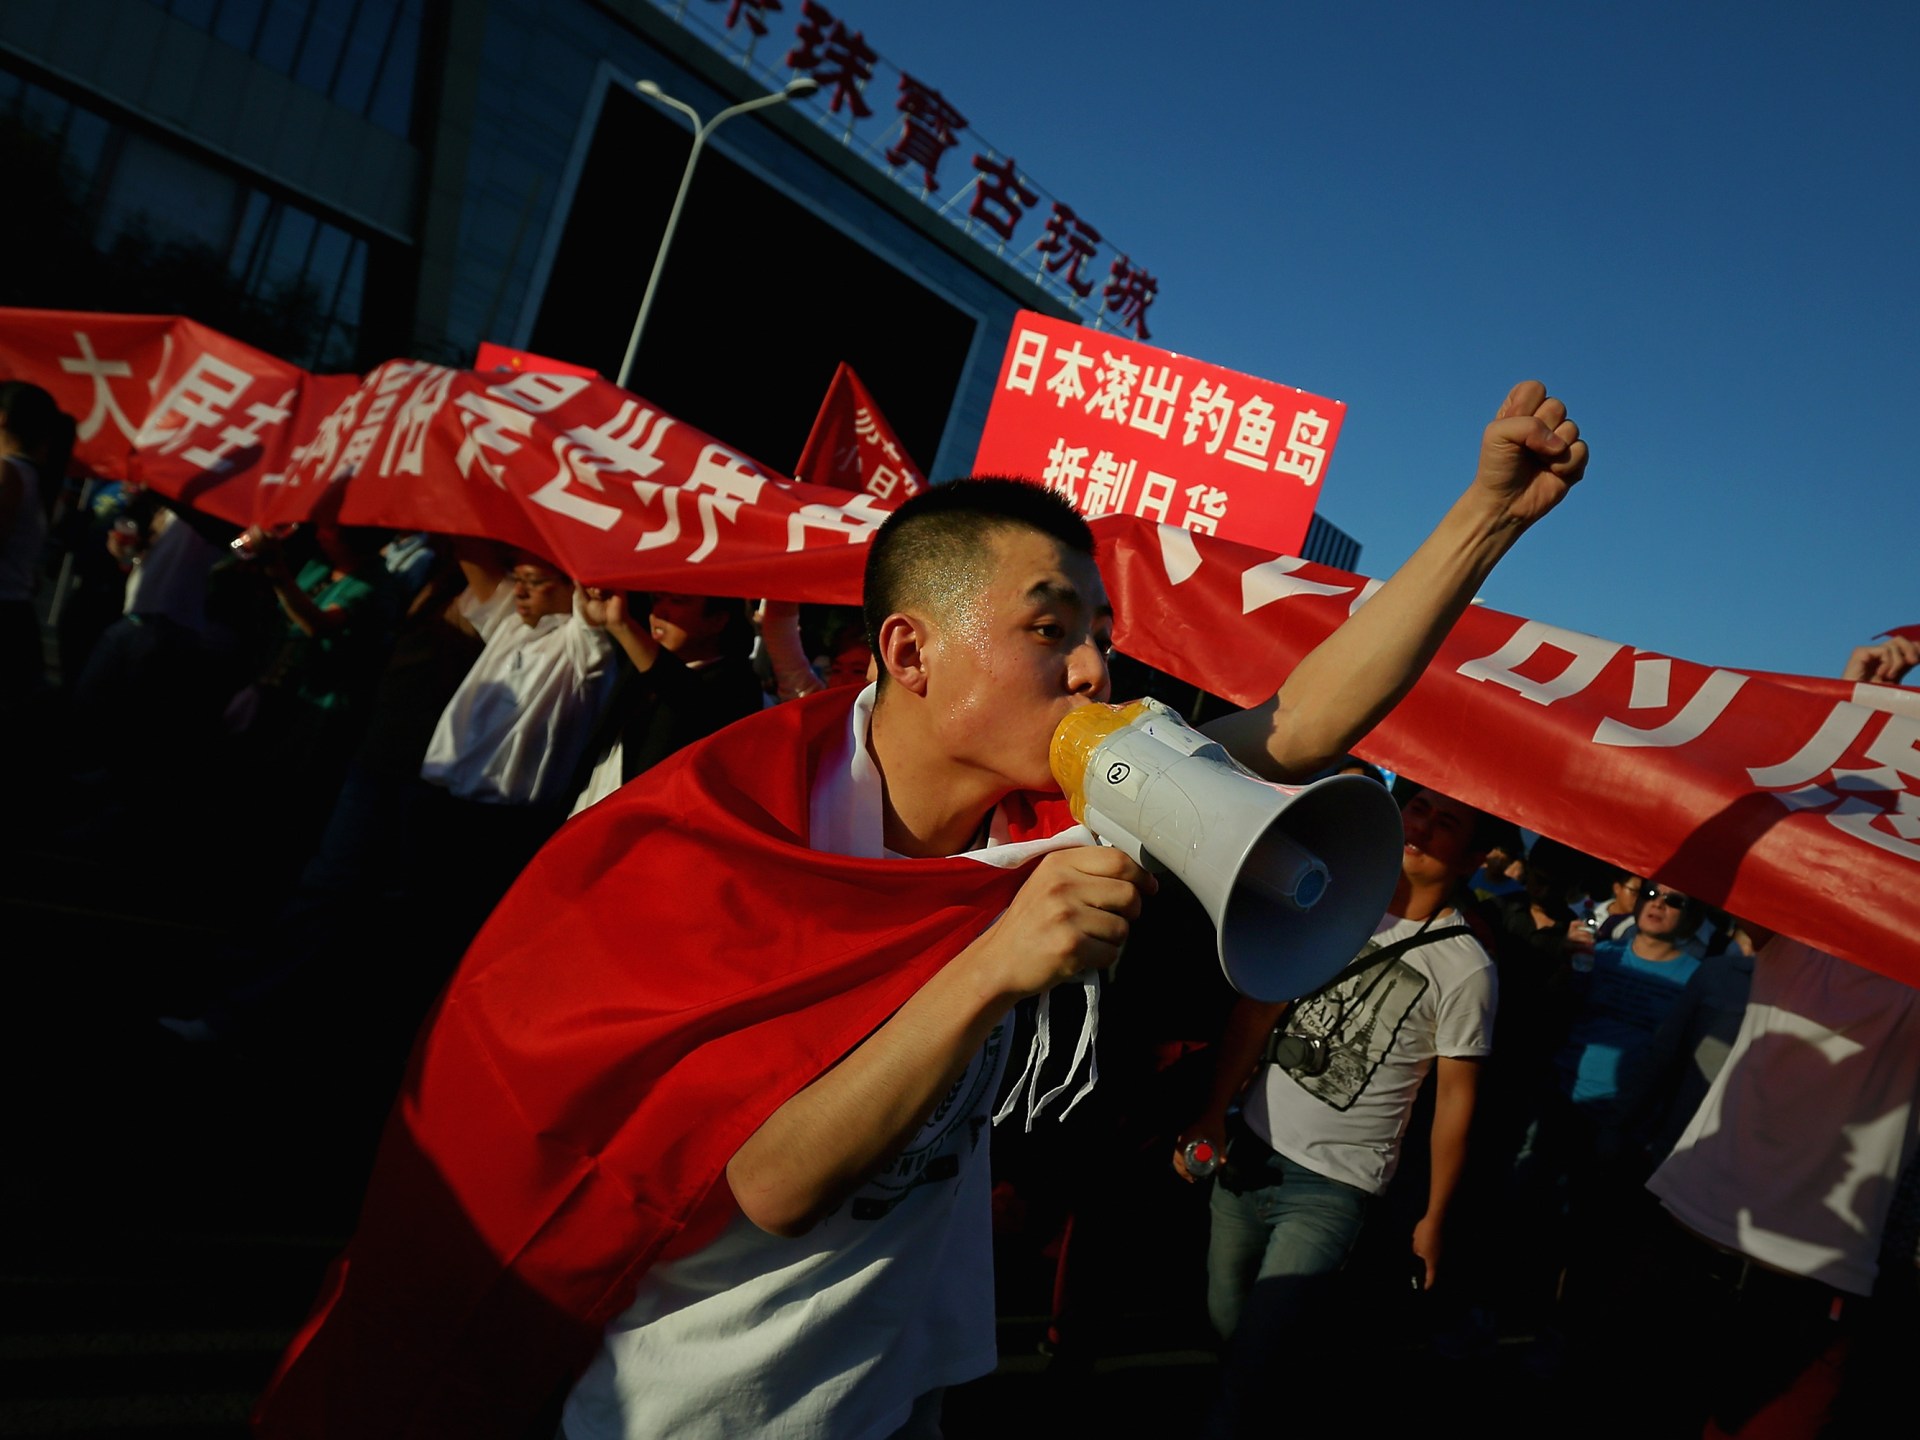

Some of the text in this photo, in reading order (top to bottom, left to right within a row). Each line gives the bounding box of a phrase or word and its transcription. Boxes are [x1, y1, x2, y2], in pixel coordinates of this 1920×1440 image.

[1005, 329, 1330, 487] 日本滚出钓鱼岛
[1042, 437, 1228, 536] 抵制日货
